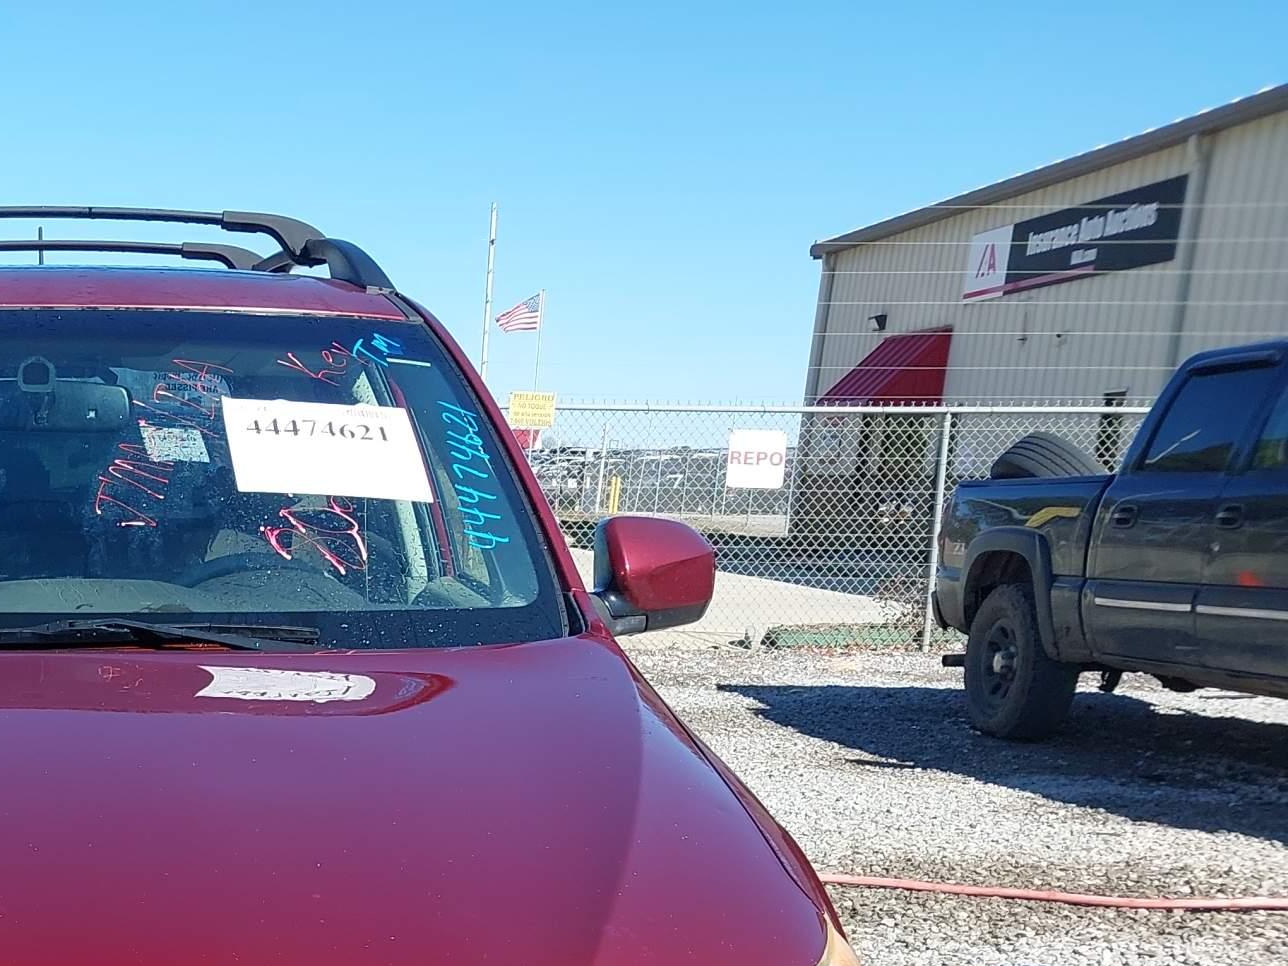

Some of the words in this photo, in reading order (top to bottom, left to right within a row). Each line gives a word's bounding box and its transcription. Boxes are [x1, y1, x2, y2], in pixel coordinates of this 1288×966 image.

[276, 341, 370, 387] Key
[246, 418, 390, 442] 44474621
[730, 451, 783, 467] REPO
